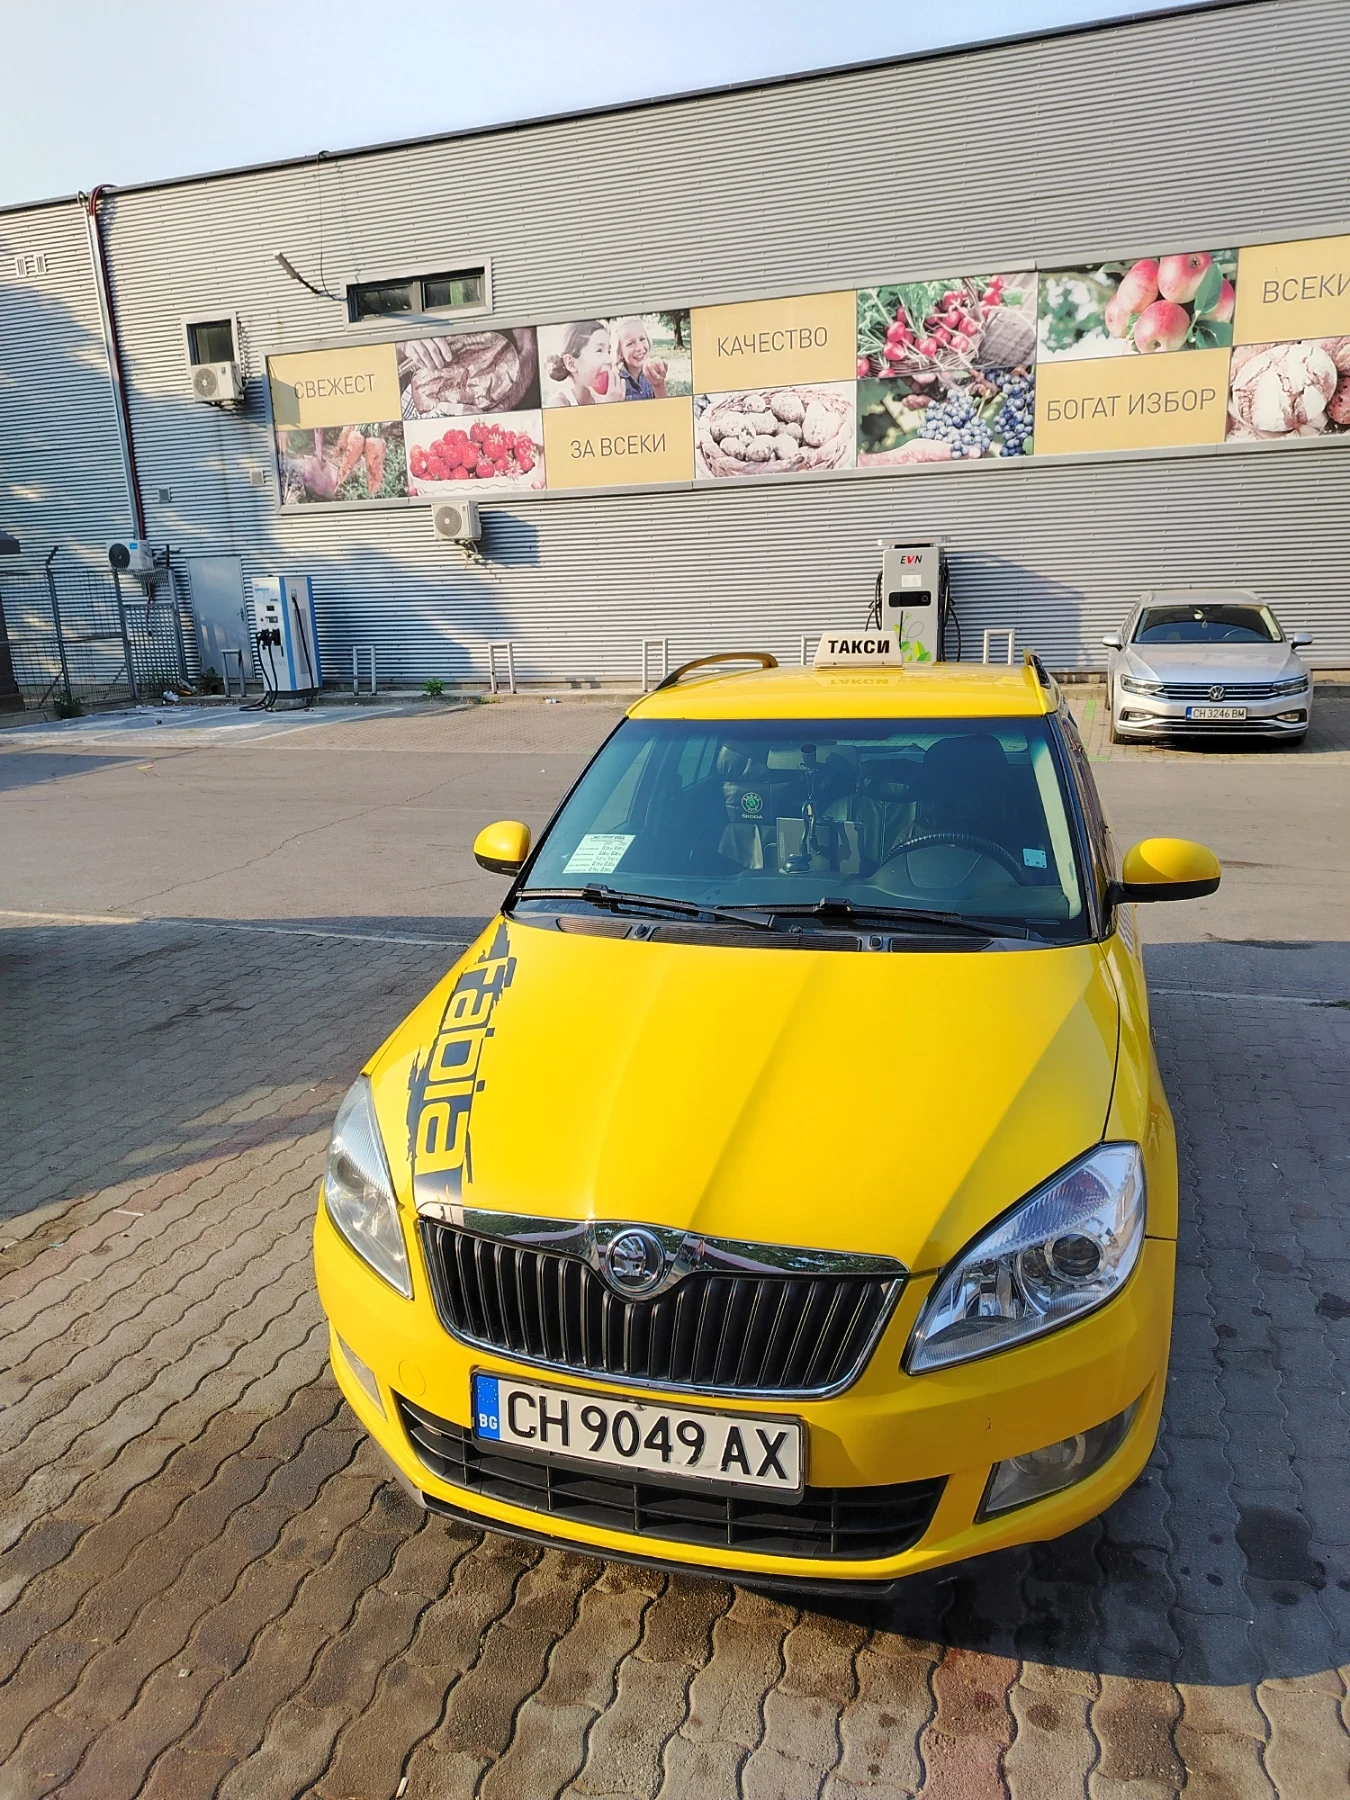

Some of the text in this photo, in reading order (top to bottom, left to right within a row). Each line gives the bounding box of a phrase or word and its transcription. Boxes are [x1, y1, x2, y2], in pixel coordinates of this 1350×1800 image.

[717, 326, 828, 357] КАЧЕСТВО
[293, 373, 375, 399] СВЕЖЕСТ
[1046, 388, 1216, 421] БОГАТ ИЗБОР
[570, 433, 666, 459] ЗА ВСЕКИ
[900, 554, 923, 565] EVN
[828, 640, 890, 654] ТАКСИ
[1193, 708, 1206, 718] CH
[1207, 708, 1231, 719] 3246
[413, 956, 517, 1177] Fabia
[478, 1413, 498, 1430] BG
[507, 1391, 788, 1480] CH 9049 AX
